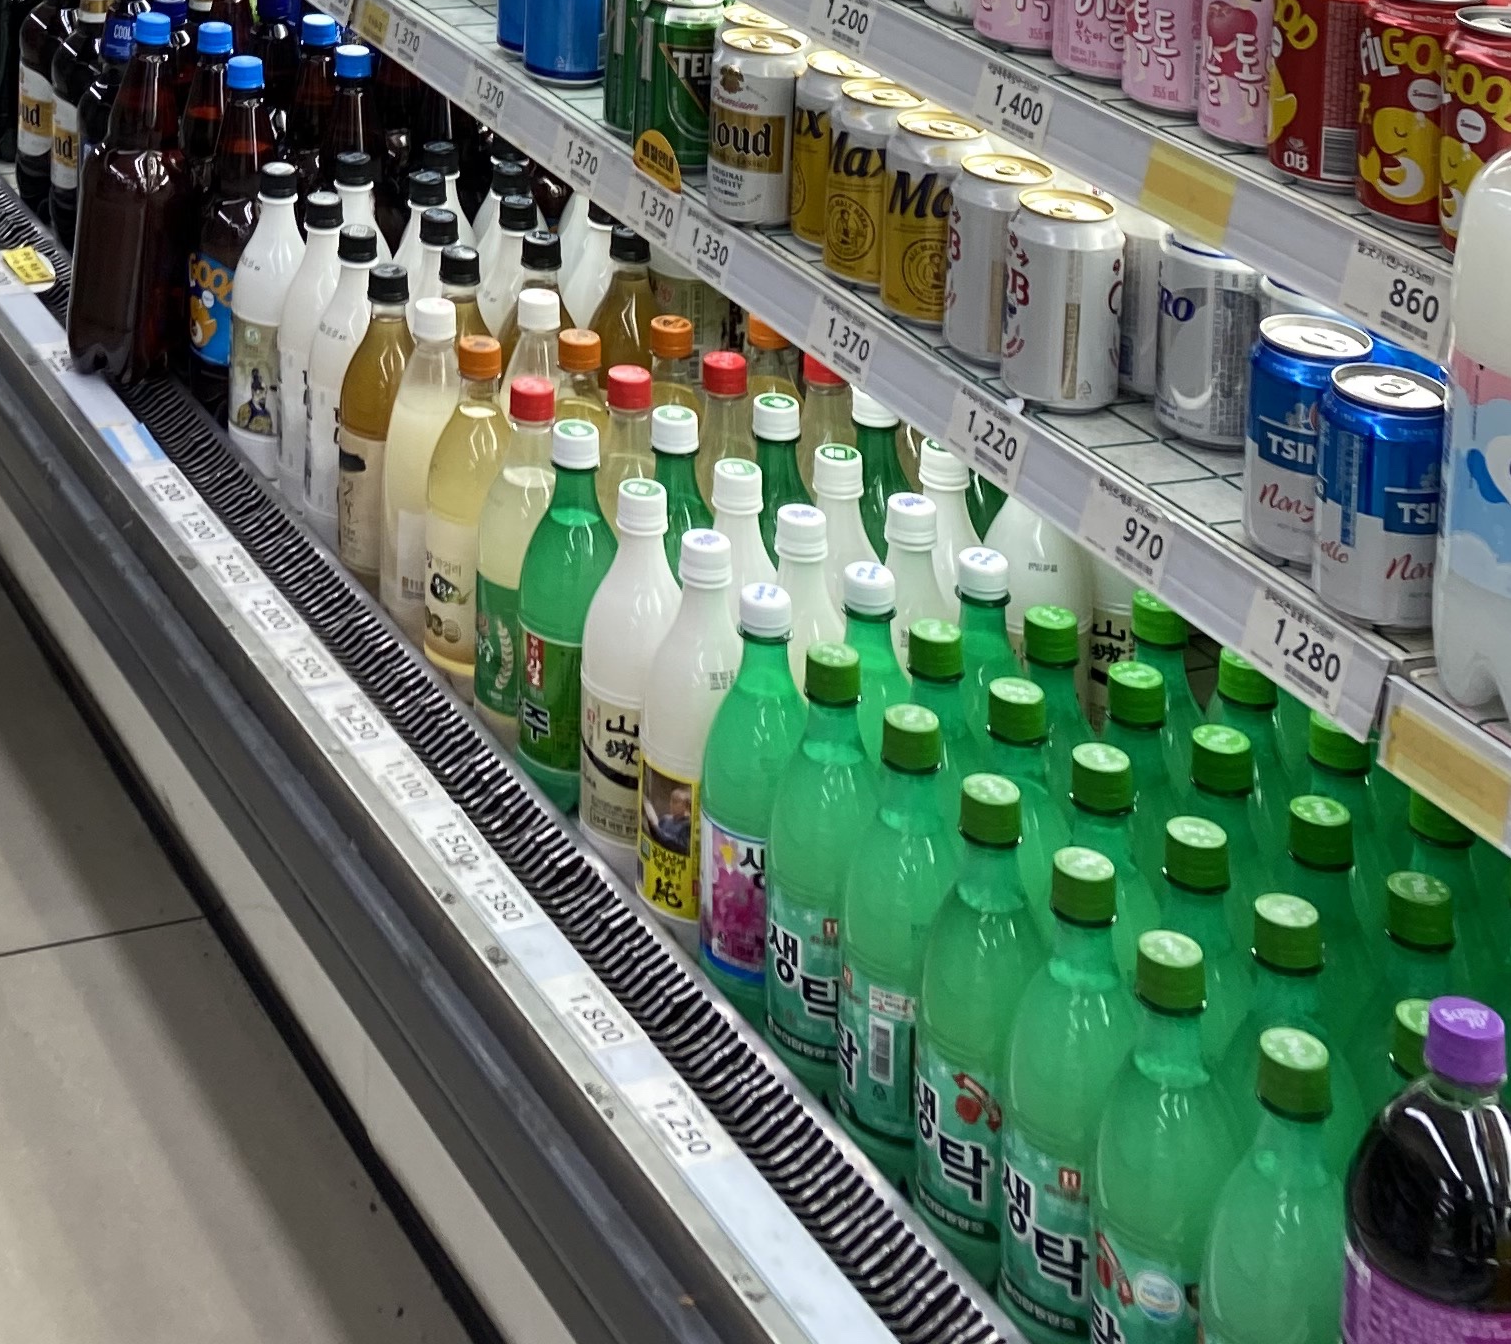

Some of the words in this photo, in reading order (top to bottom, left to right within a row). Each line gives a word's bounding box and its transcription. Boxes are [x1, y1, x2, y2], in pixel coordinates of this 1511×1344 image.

[394, 25, 420, 51] 1,370
[475, 77, 505, 108] 1,370
[995, 82, 1044, 126] 1,400
[566, 140, 599, 176] 1,370
[1283, 150, 1309, 173] OB
[640, 190, 674, 228] 1,370
[692, 227, 729, 266] 1,330
[1389, 277, 1440, 323] 860
[827, 317, 870, 362] 1,370
[966, 410, 1019, 462] 1,220
[1123, 516, 1164, 561] 970
[1273, 617, 1342, 683] 1,280
[341, 703, 380, 742] 1,250
[384, 760, 429, 801] 1,100
[654, 1100, 712, 1157] 1,250
[1002, 1161, 1090, 1297] 생탁
